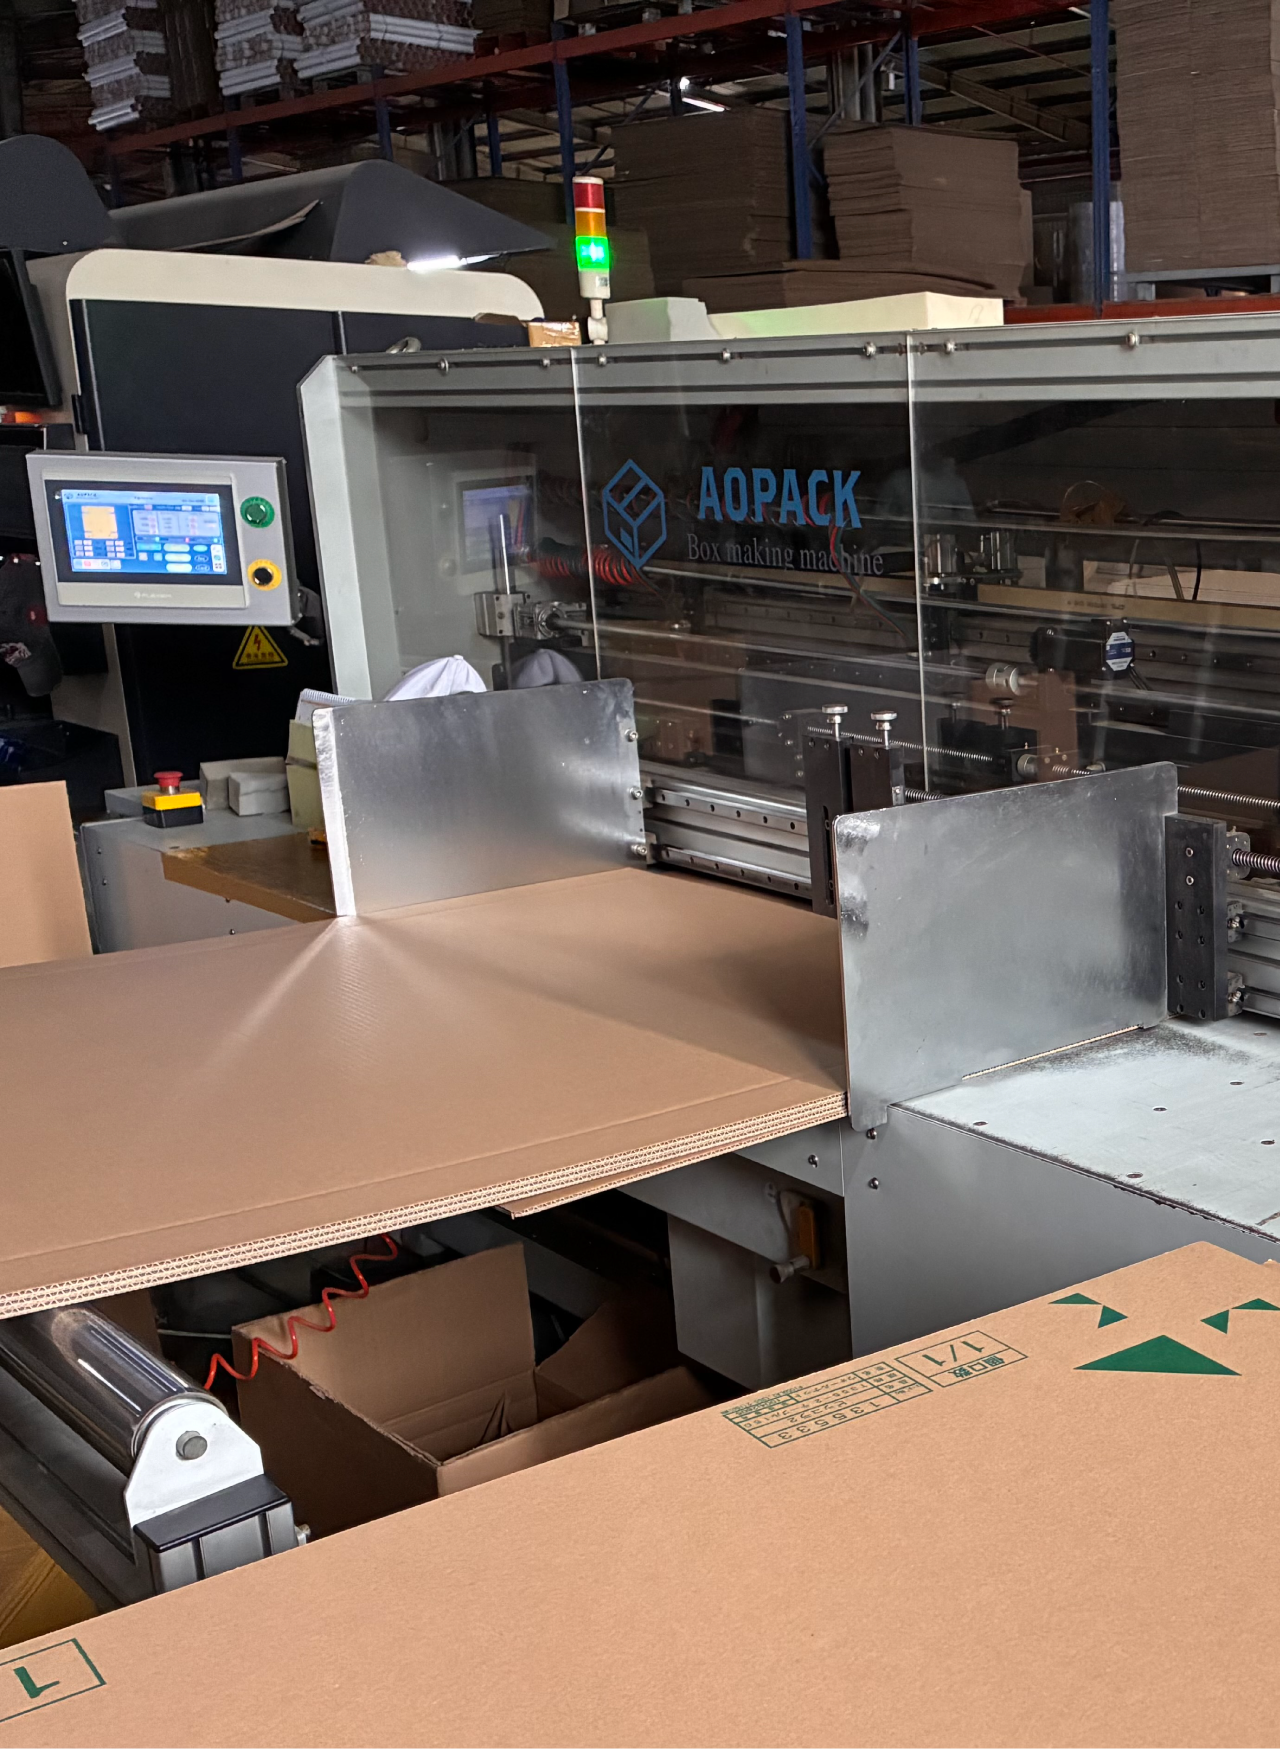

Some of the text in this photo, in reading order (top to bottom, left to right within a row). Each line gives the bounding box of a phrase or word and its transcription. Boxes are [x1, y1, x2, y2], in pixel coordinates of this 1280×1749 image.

[697, 466, 862, 528] AOPACK
[688, 533, 884, 575] Box making machine
[922, 1341, 985, 1366] 1/1
